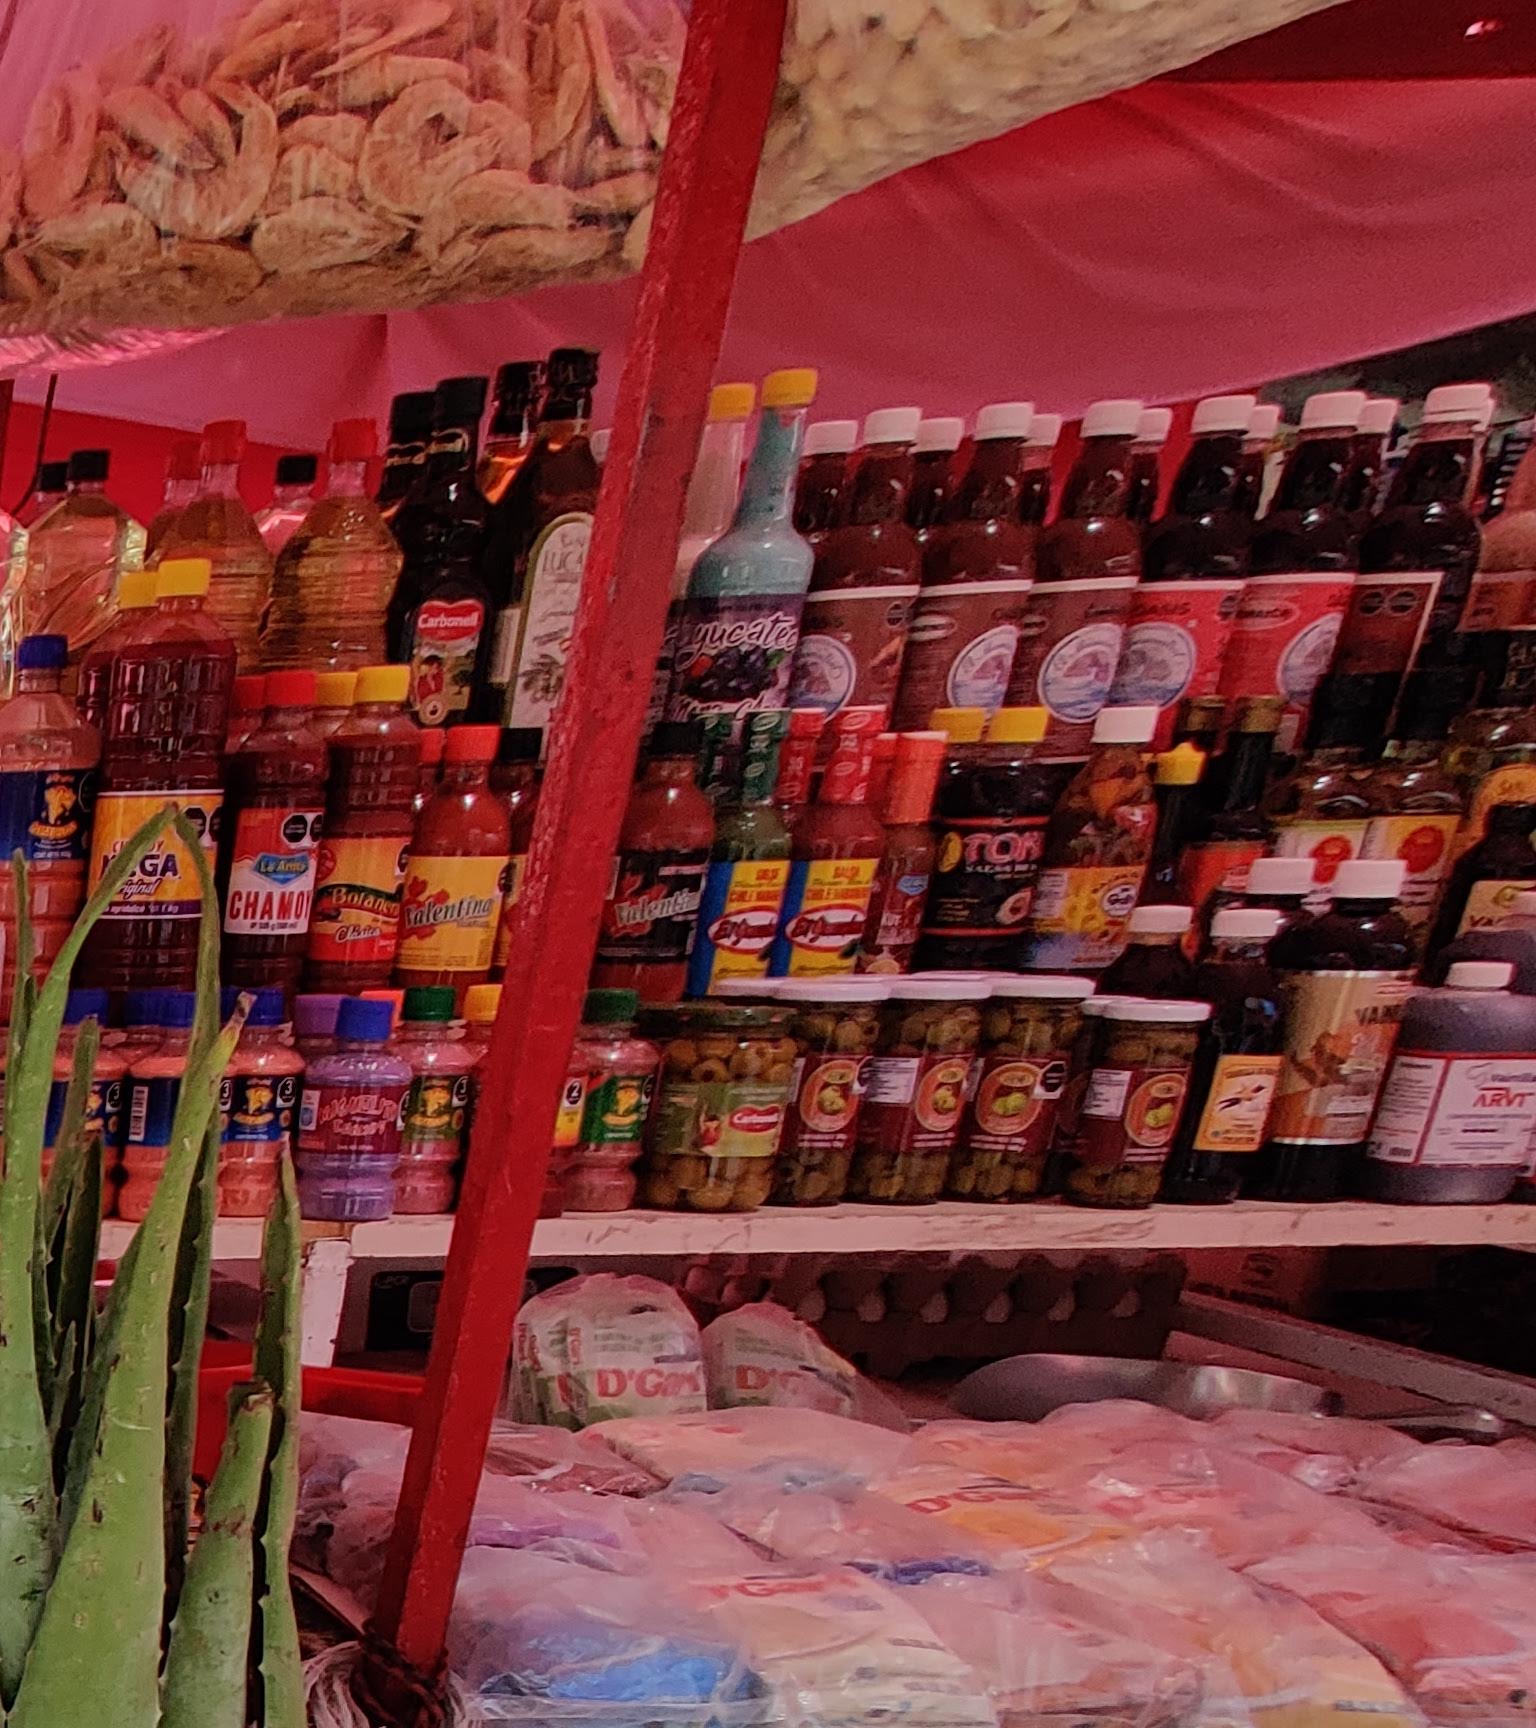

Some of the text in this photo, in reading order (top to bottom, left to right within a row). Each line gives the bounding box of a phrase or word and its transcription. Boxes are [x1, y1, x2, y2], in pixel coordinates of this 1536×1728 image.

[417, 611, 480, 629] Carbonell
[331, 887, 399, 915] Botaner
[404, 898, 493, 928] Valentina
